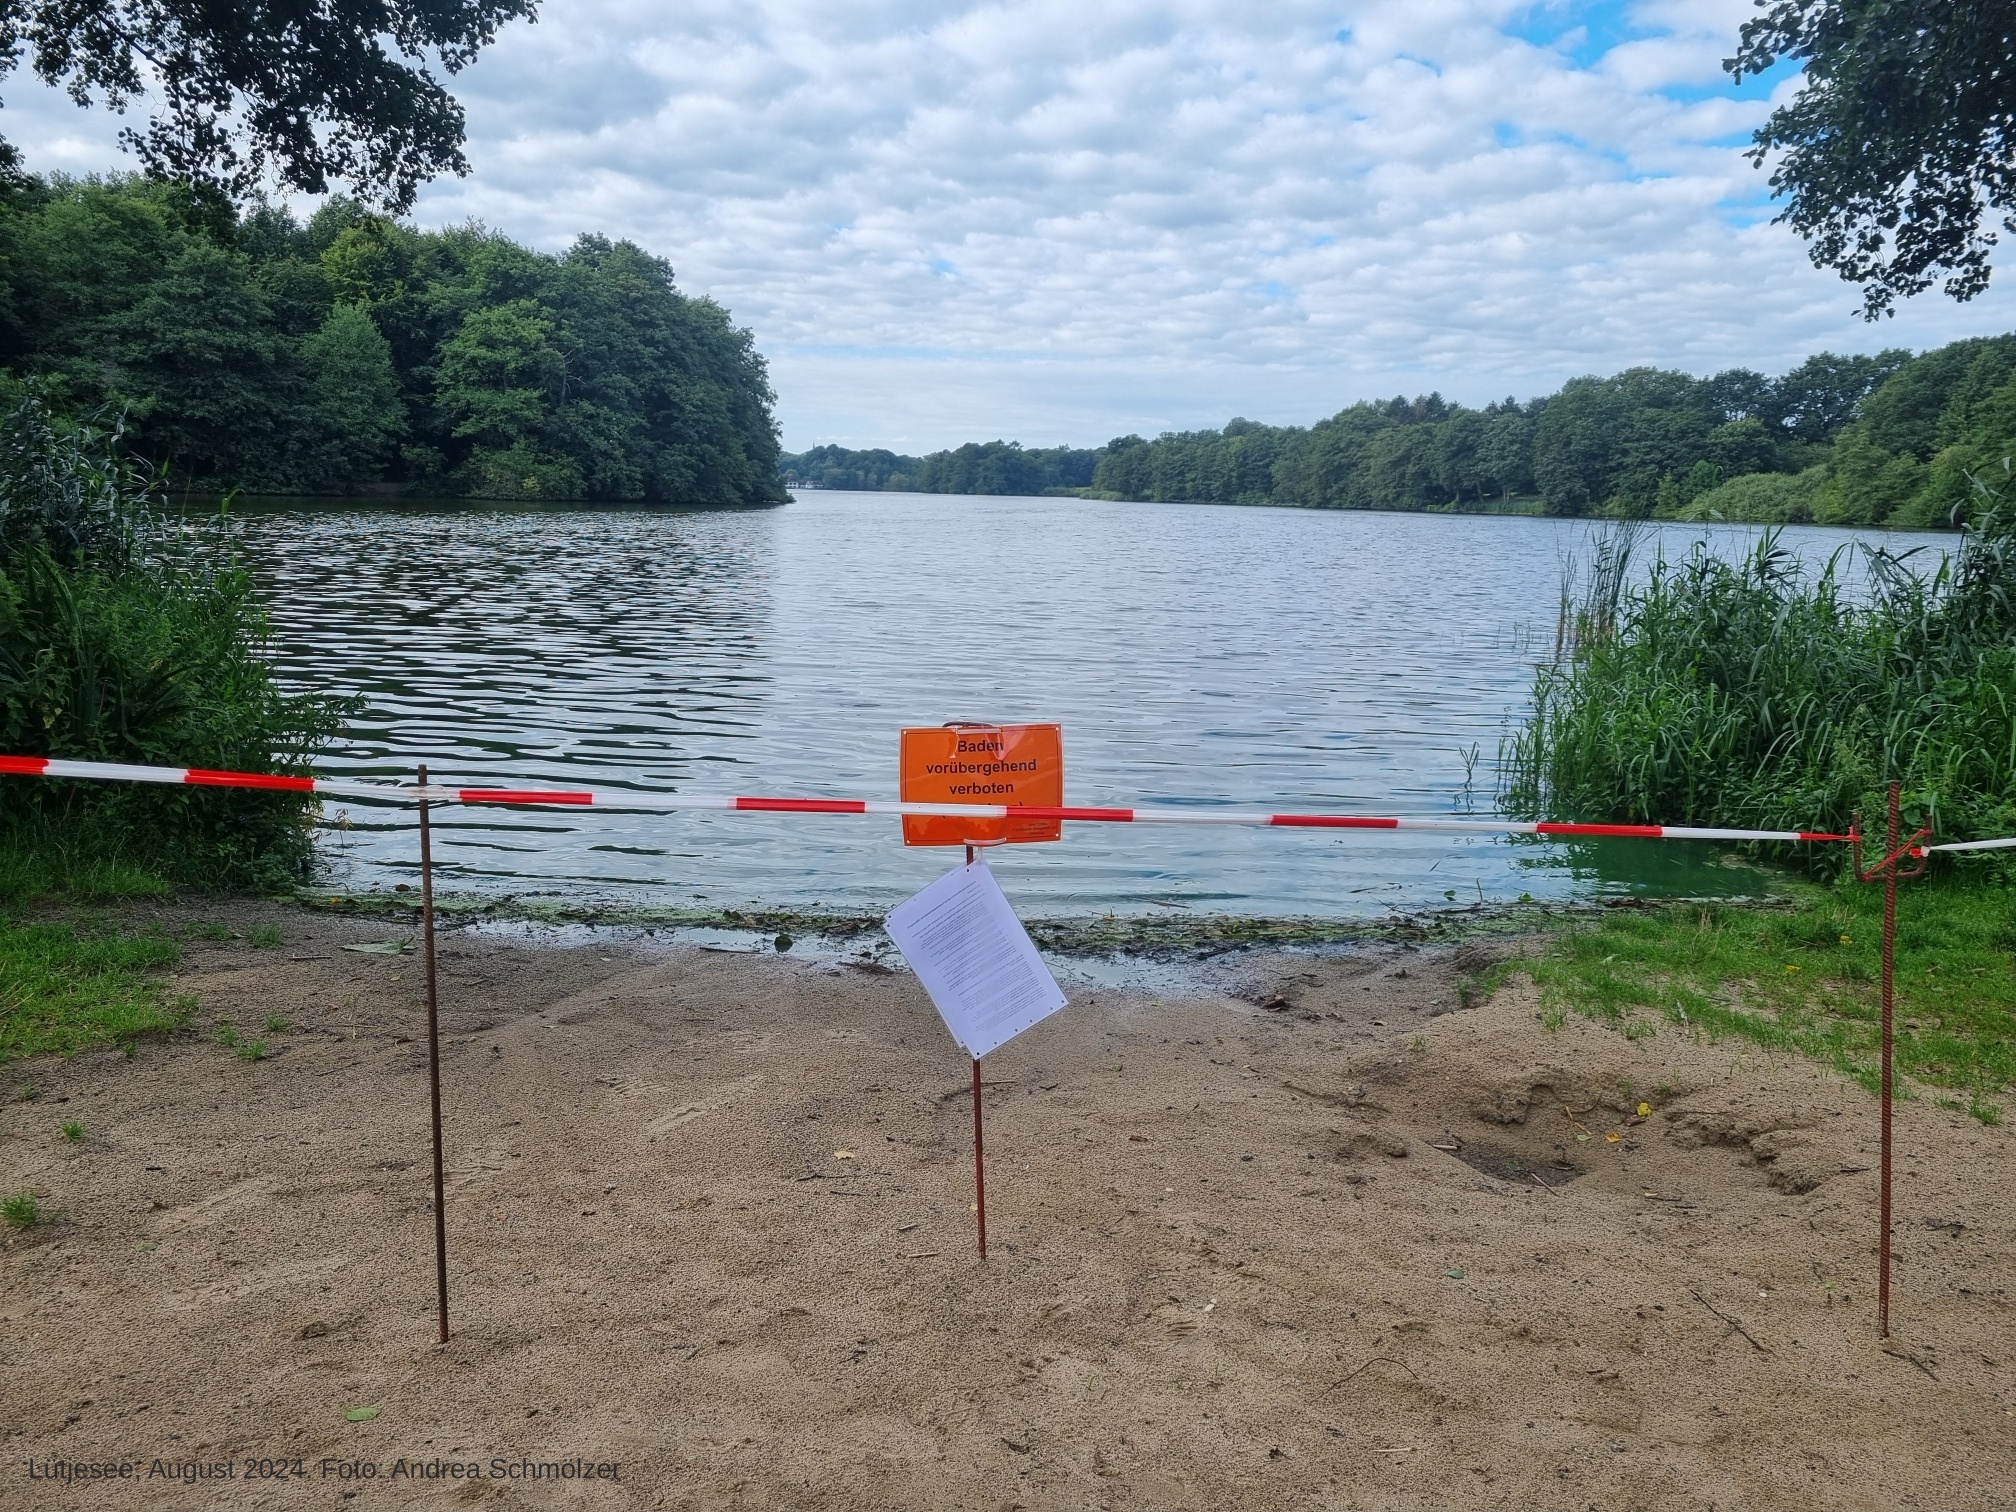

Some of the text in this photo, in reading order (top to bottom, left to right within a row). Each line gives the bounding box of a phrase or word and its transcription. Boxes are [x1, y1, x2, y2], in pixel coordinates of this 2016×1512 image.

[958, 740, 1003, 752] Baden
[926, 759, 1036, 776] vorübergehend
[949, 782, 1014, 795] verboten
